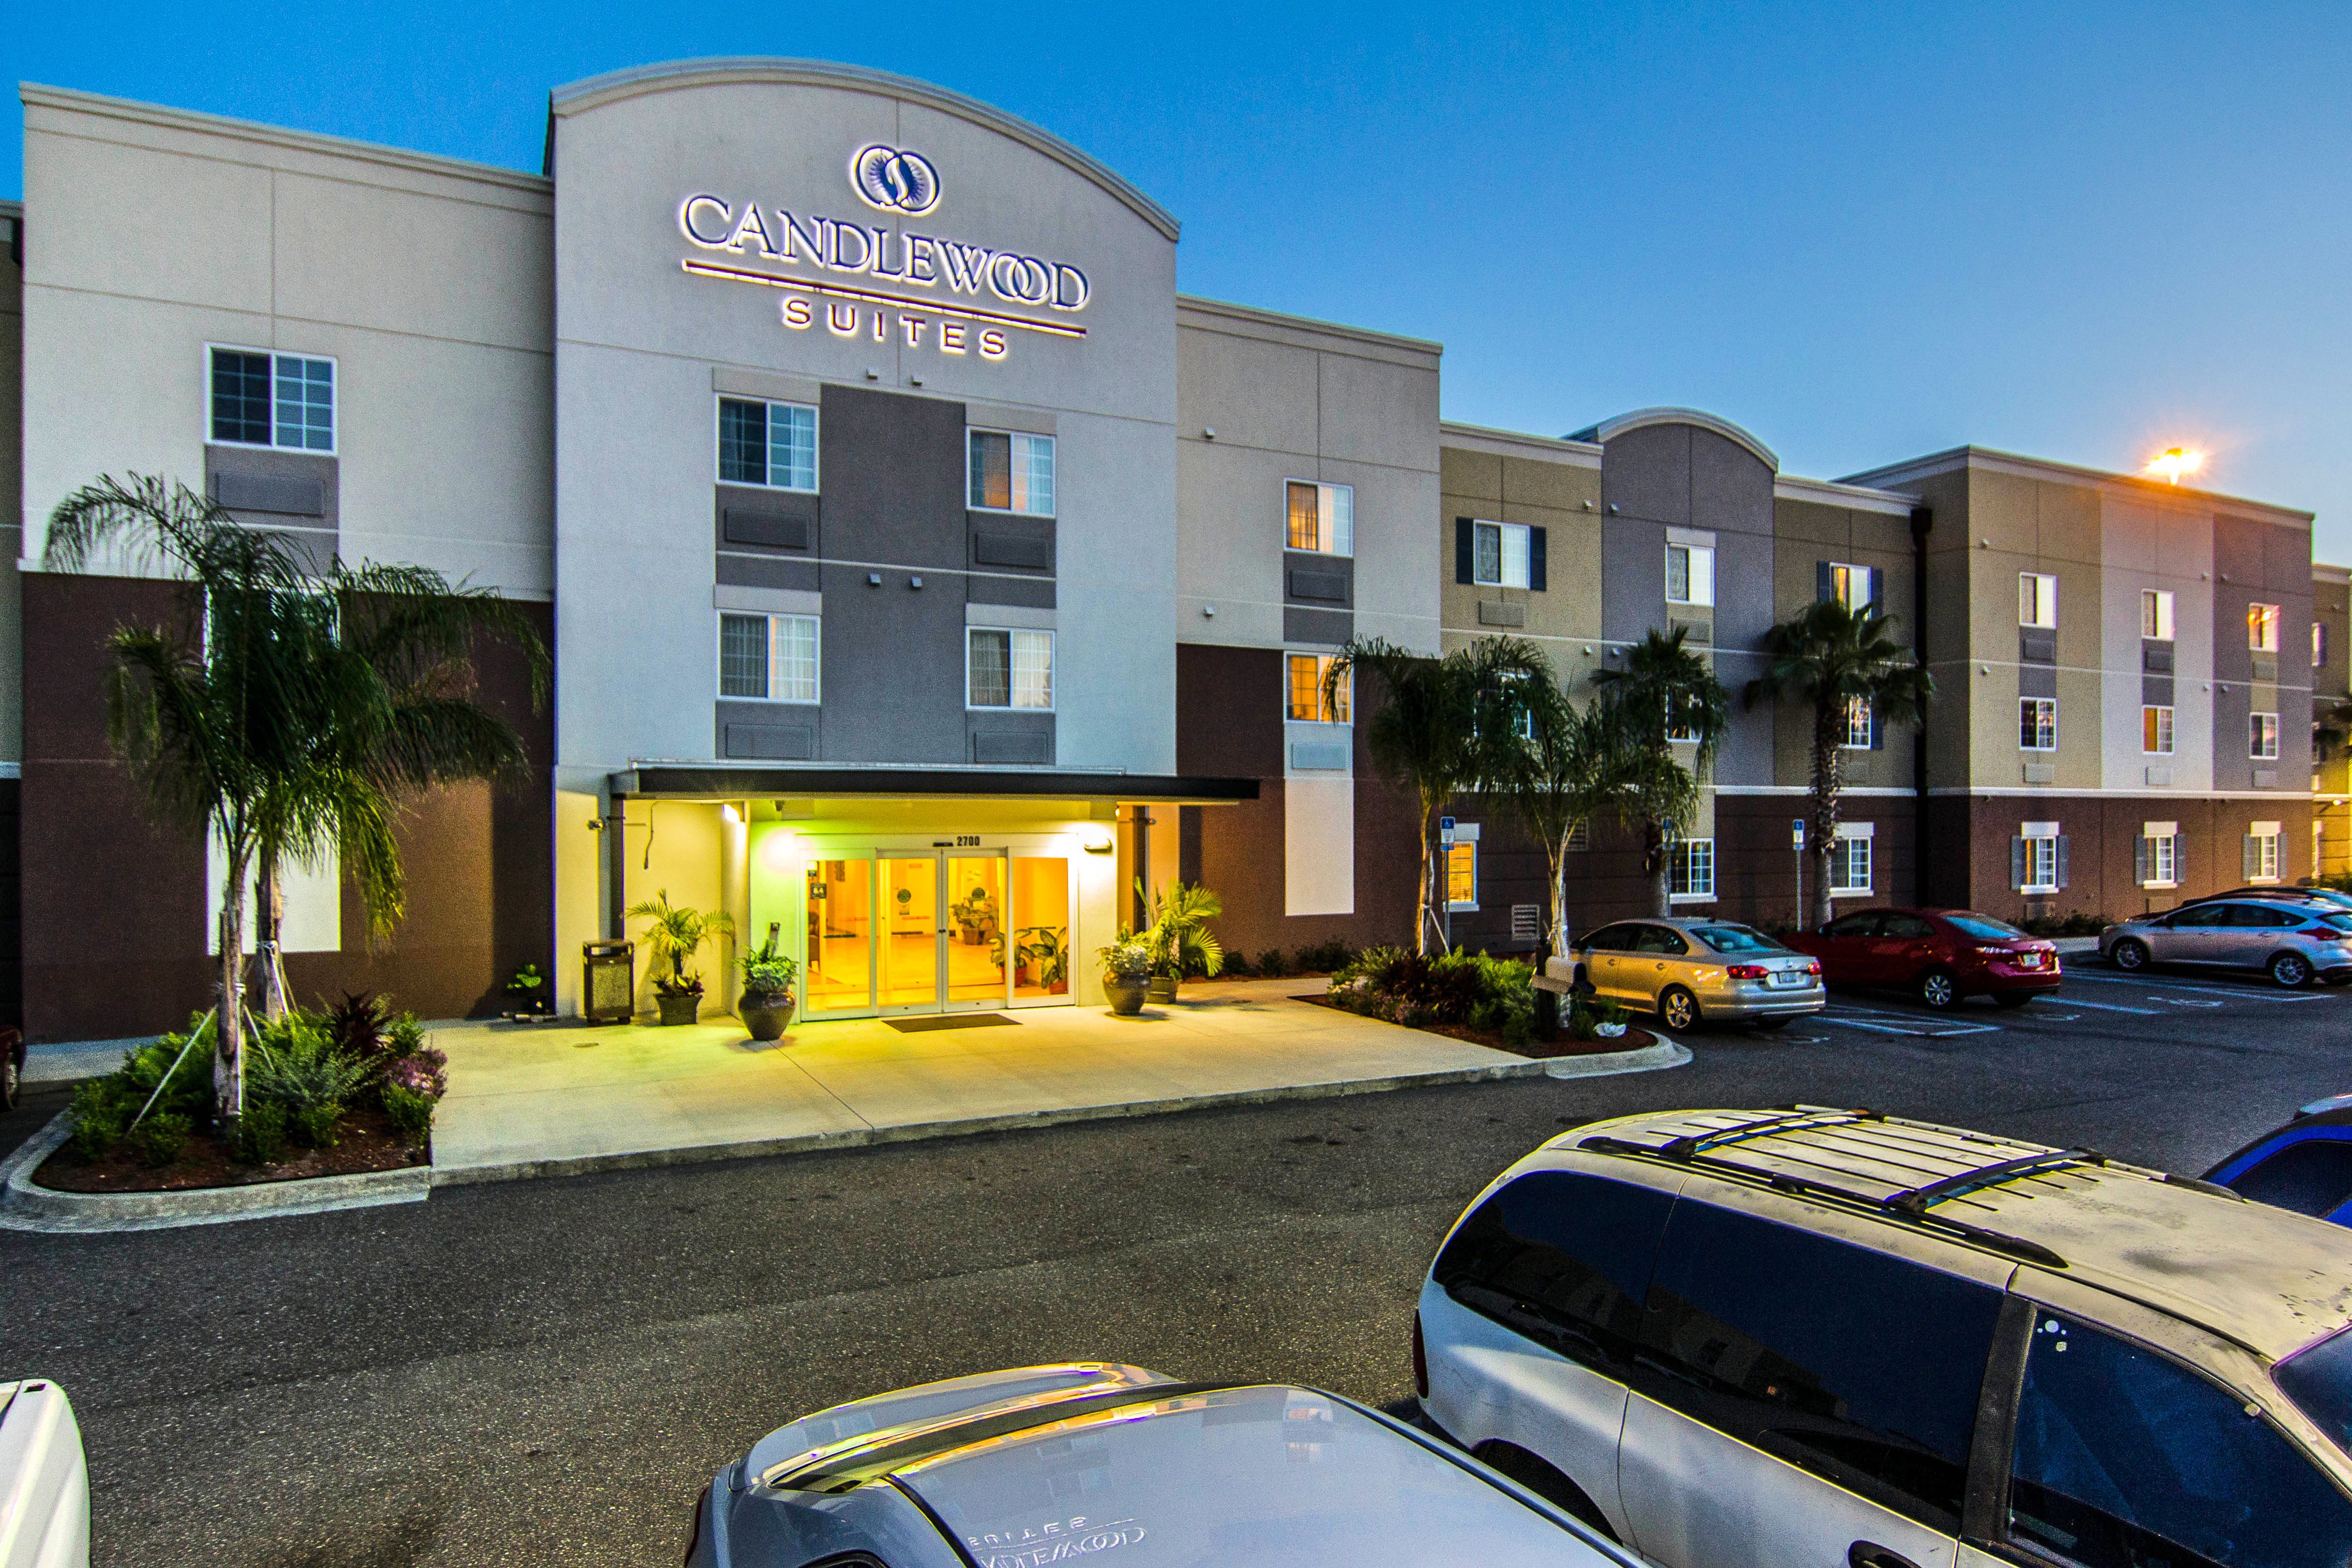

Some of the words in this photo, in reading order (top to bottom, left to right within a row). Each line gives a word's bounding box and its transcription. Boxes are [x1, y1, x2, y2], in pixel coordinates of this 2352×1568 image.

[681, 195, 1090, 310] CANDLEWOOD
[784, 298, 1007, 360] SUITES
[957, 836, 980, 846] 2700
